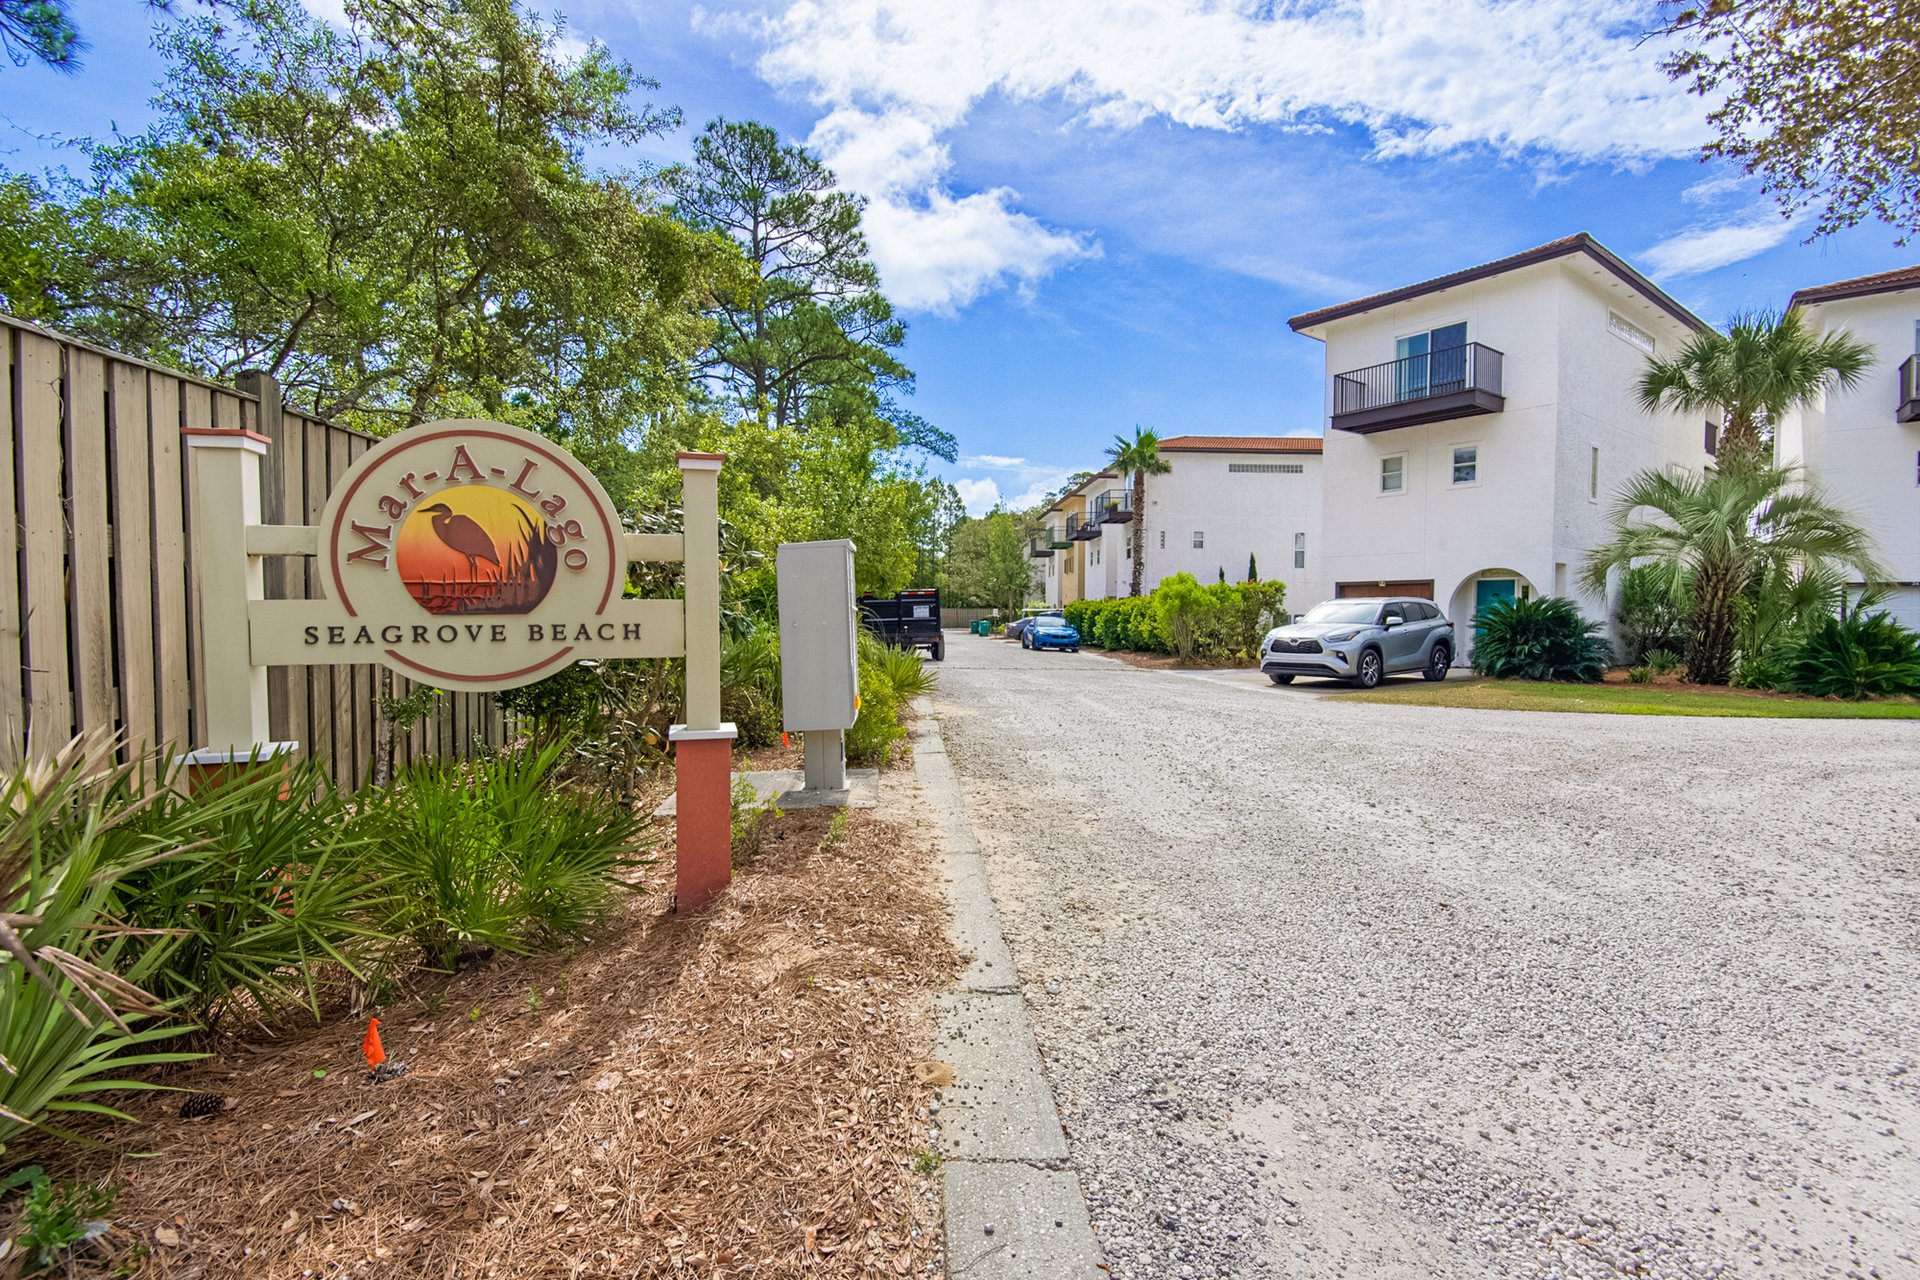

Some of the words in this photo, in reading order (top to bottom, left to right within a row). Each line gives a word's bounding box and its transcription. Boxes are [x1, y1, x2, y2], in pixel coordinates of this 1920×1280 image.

[346, 443, 588, 573] Mar-A-Lago
[304, 625, 507, 645] SEAGROVE
[528, 623, 642, 642] BEACH
